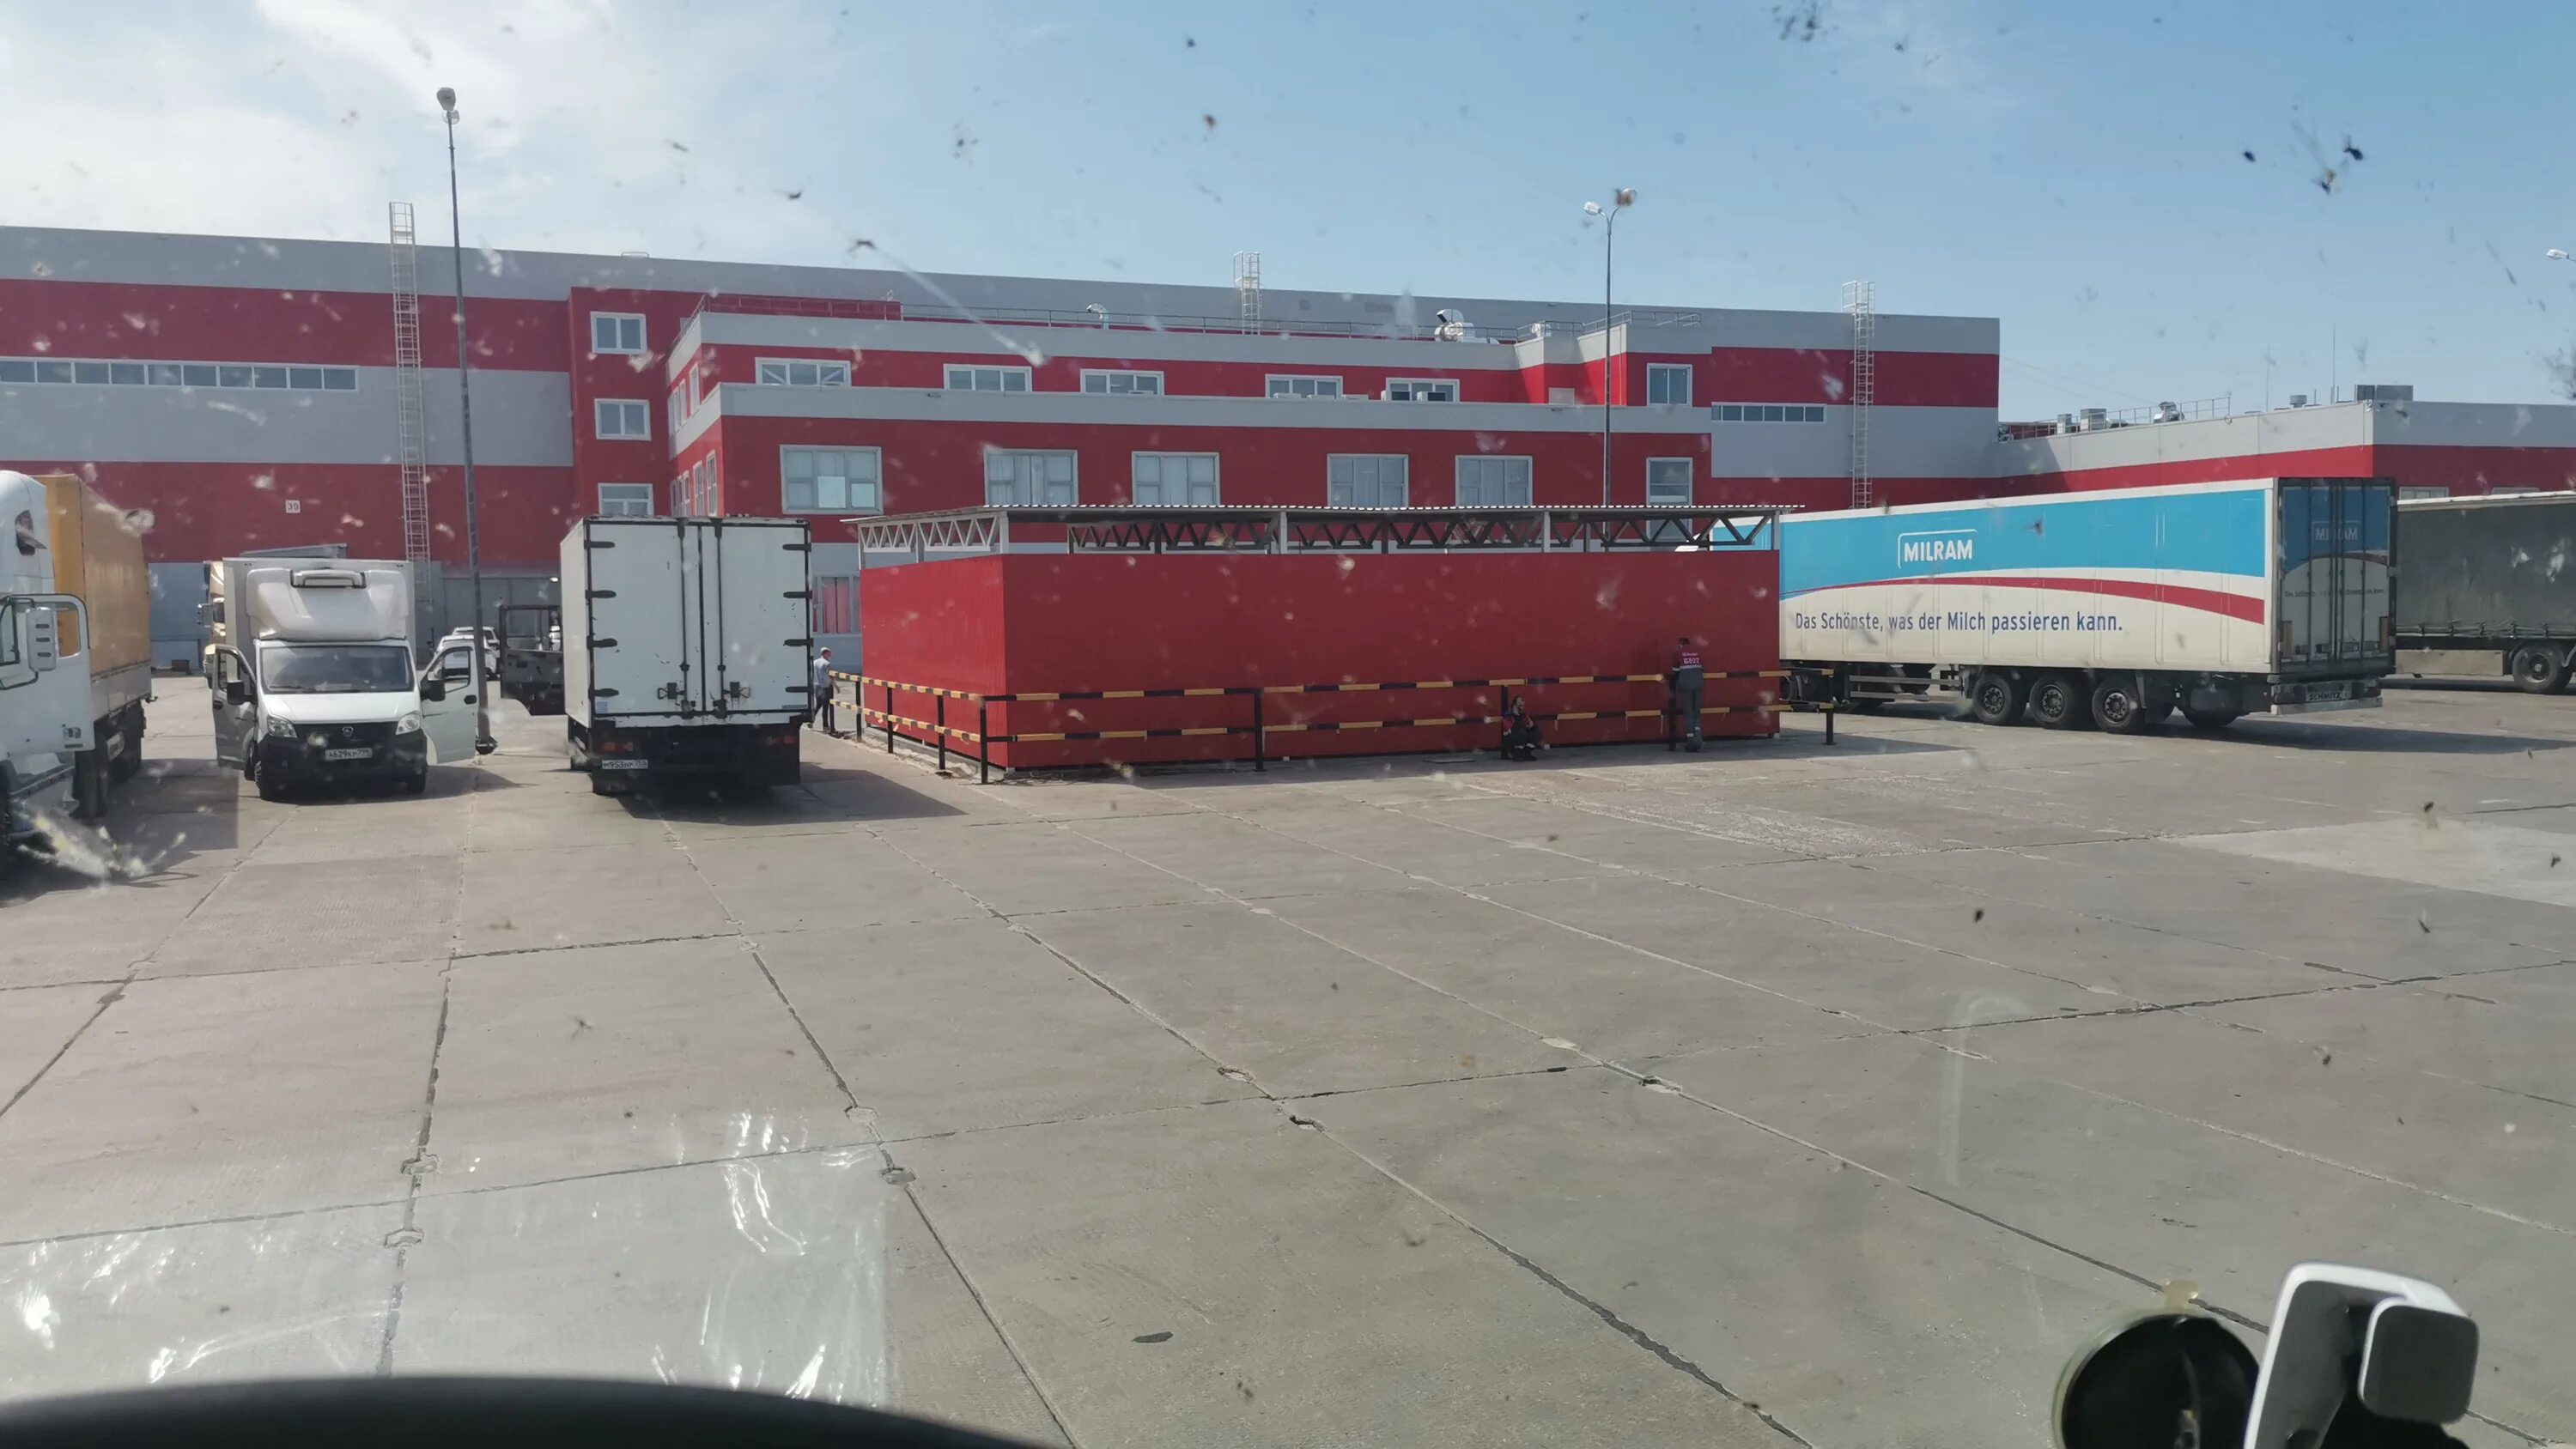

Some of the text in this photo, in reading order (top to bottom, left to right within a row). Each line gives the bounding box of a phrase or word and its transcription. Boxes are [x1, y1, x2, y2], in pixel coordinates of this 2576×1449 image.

[1904, 539, 1973, 562] MILRAM
[1795, 611, 2123, 635] Das Schönste, was der Milch passieren kann.
